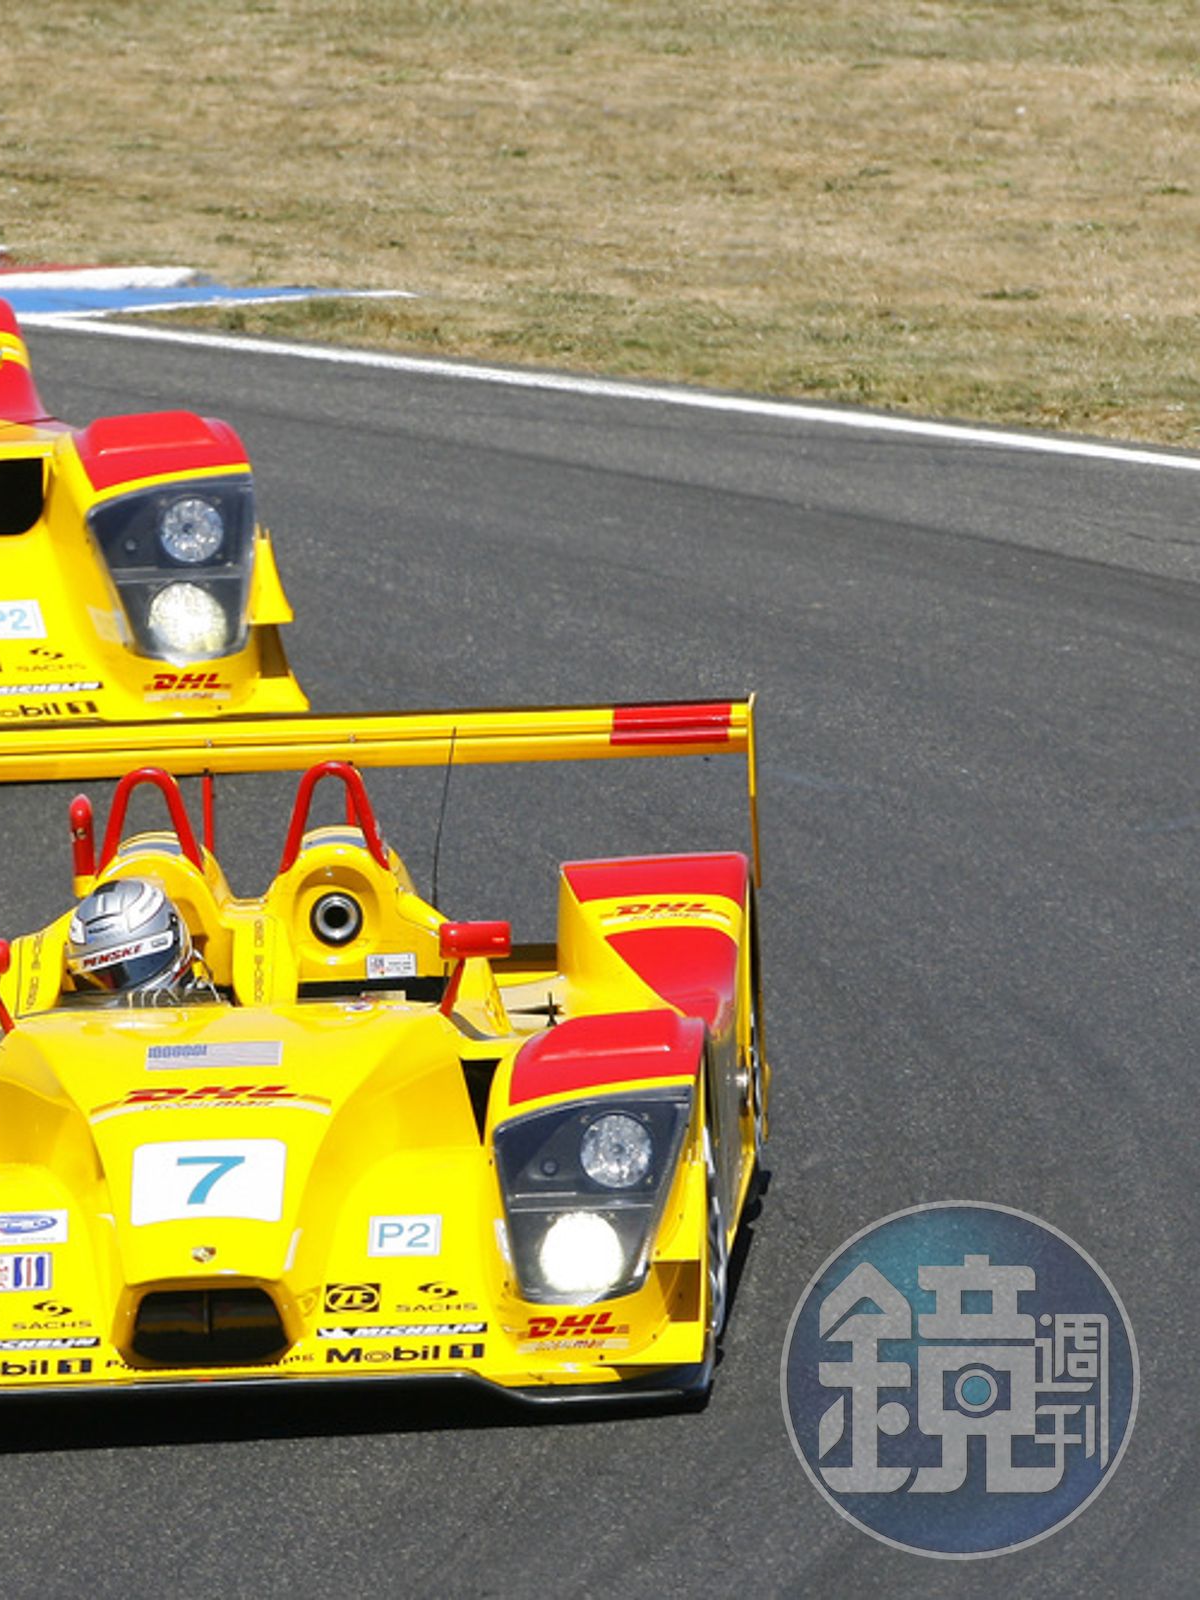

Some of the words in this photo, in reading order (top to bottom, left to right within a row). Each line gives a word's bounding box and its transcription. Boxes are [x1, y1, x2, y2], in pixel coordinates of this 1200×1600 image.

[153, 673, 221, 689] DHL
[616, 902, 713, 916] DHL
[123, 1085, 299, 1104] DHL
[176, 1155, 246, 1205] 7
[378, 1223, 431, 1248] P2
[395, 1303, 478, 1313] SACHS
[12, 1320, 92, 1330] SACHS
[353, 1323, 485, 1337] MICHELIN
[528, 1311, 616, 1338] DHL
[326, 1345, 440, 1363] Mobil
